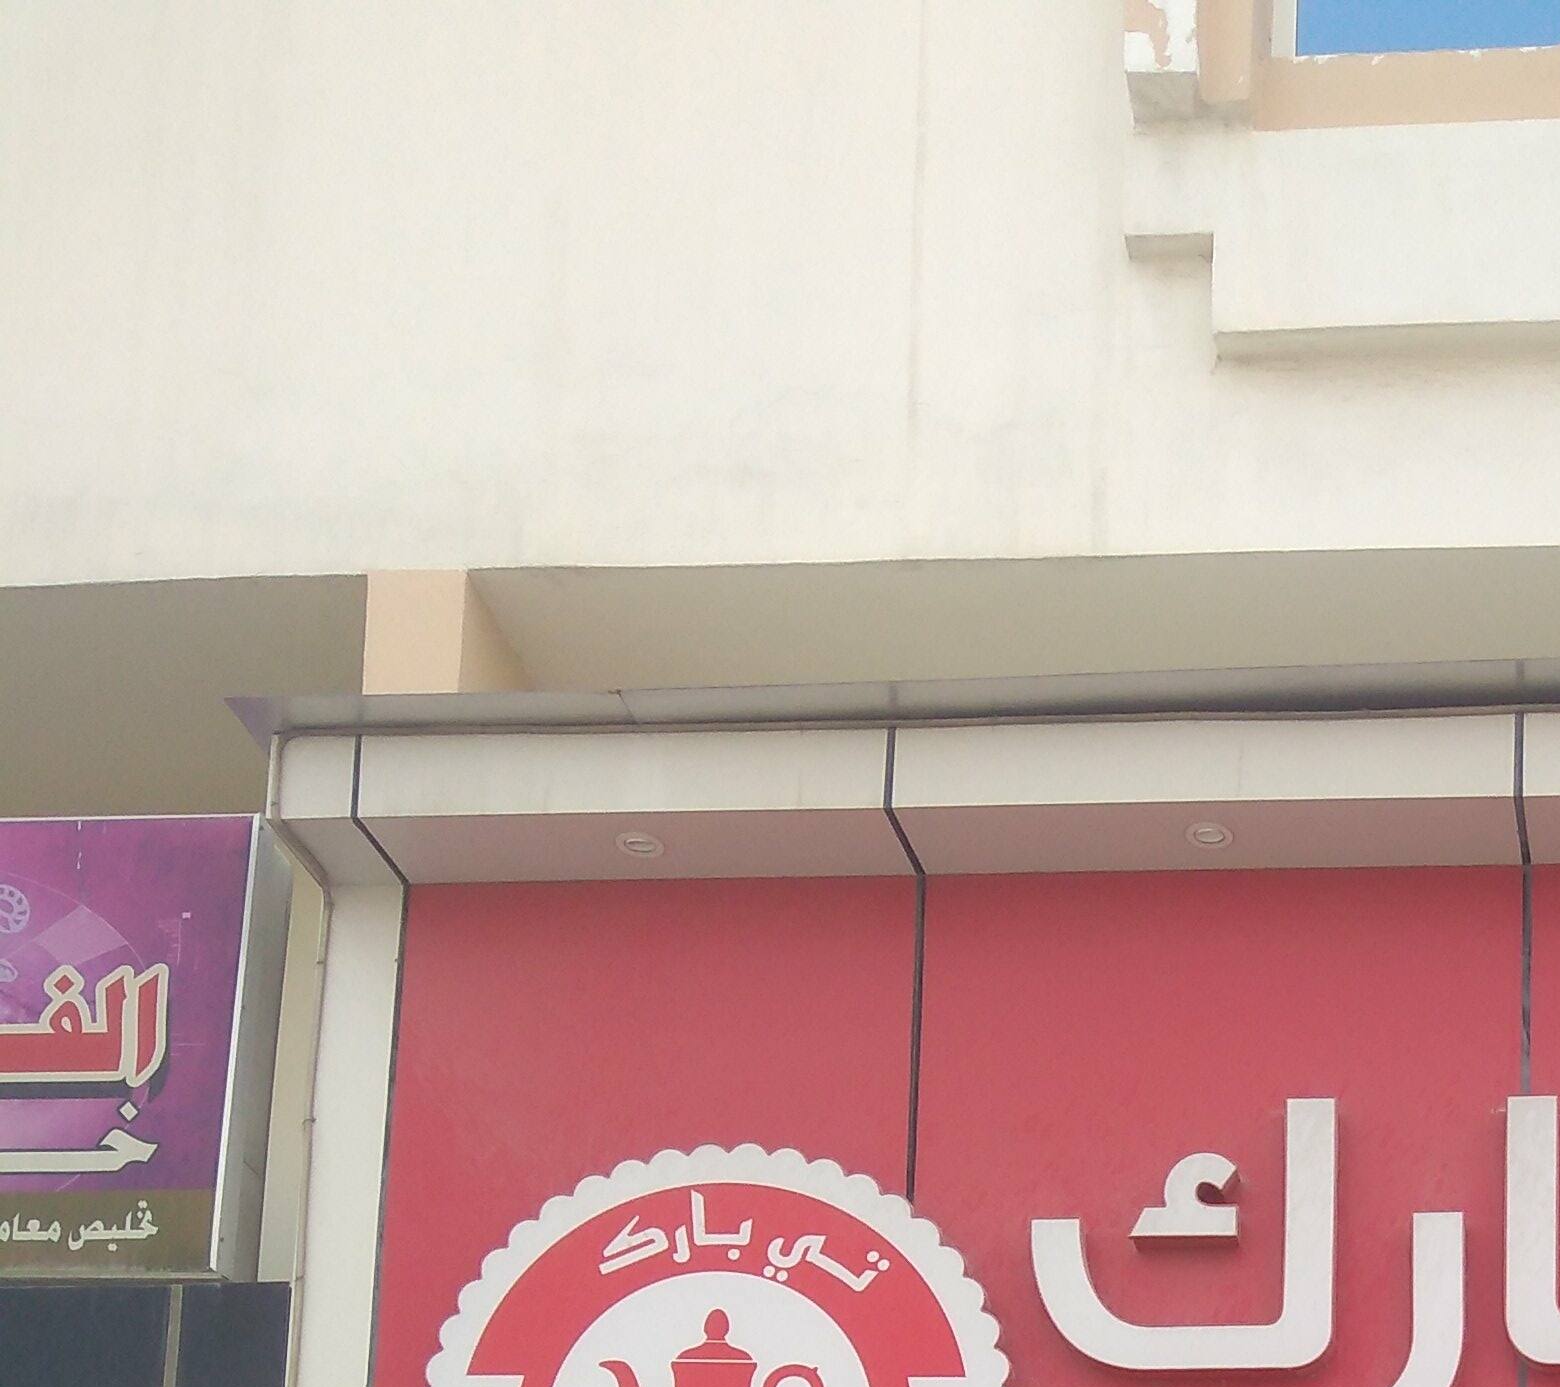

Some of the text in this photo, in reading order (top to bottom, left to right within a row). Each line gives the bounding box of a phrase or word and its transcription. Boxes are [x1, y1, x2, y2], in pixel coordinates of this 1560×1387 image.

[68, 1200, 159, 1251] تخليص
[599, 1189, 890, 1292] تي بارك
